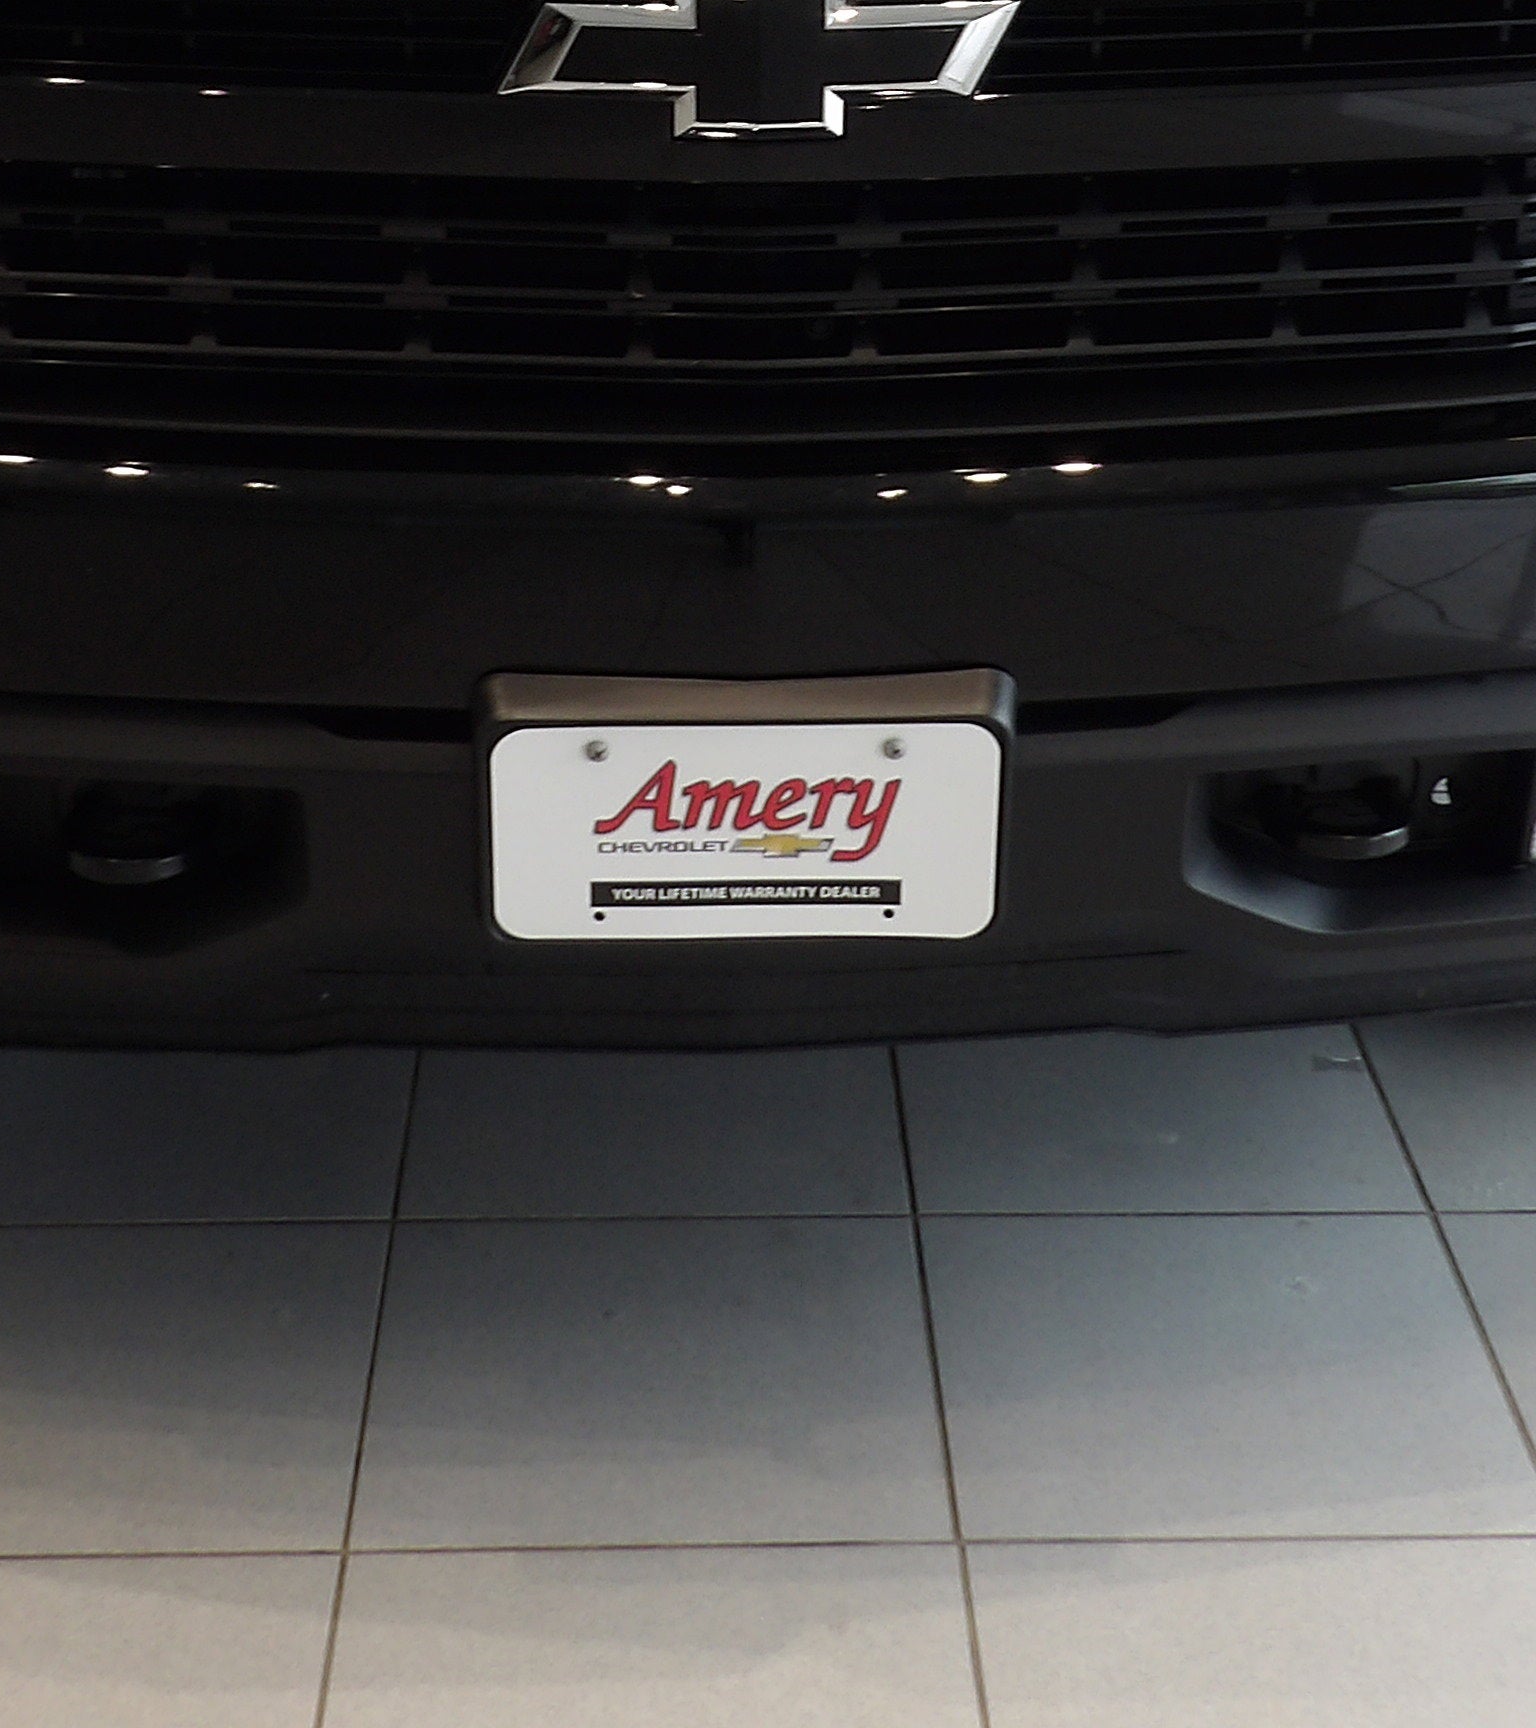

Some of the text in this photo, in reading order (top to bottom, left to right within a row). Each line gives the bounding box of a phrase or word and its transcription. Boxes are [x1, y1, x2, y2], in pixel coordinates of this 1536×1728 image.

[594, 759, 902, 862] Amery
[598, 839, 729, 853] CHEVROLET
[611, 885, 881, 901] YOUR LIFETIME WARRANTY DEALER
